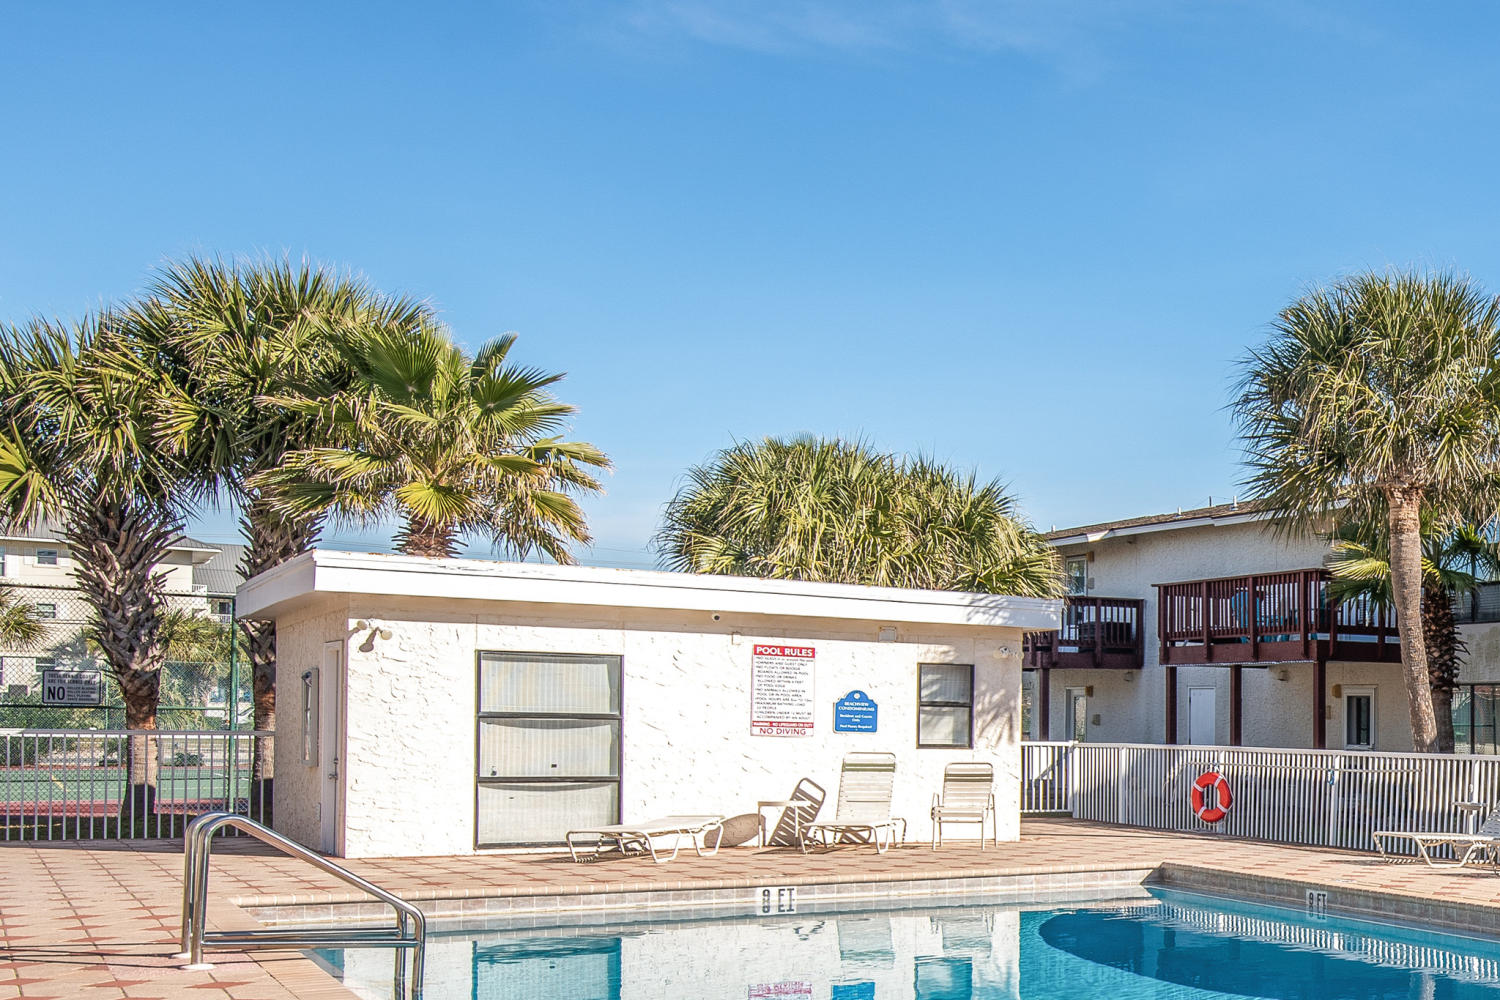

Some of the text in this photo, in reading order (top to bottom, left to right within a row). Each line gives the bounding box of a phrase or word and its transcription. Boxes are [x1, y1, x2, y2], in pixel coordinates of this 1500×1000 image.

[756, 646, 813, 657] POOL RULES
[47, 686, 66, 701] NO
[776, 728, 806, 736] DIVING
[1309, 892, 1314, 906] 9
